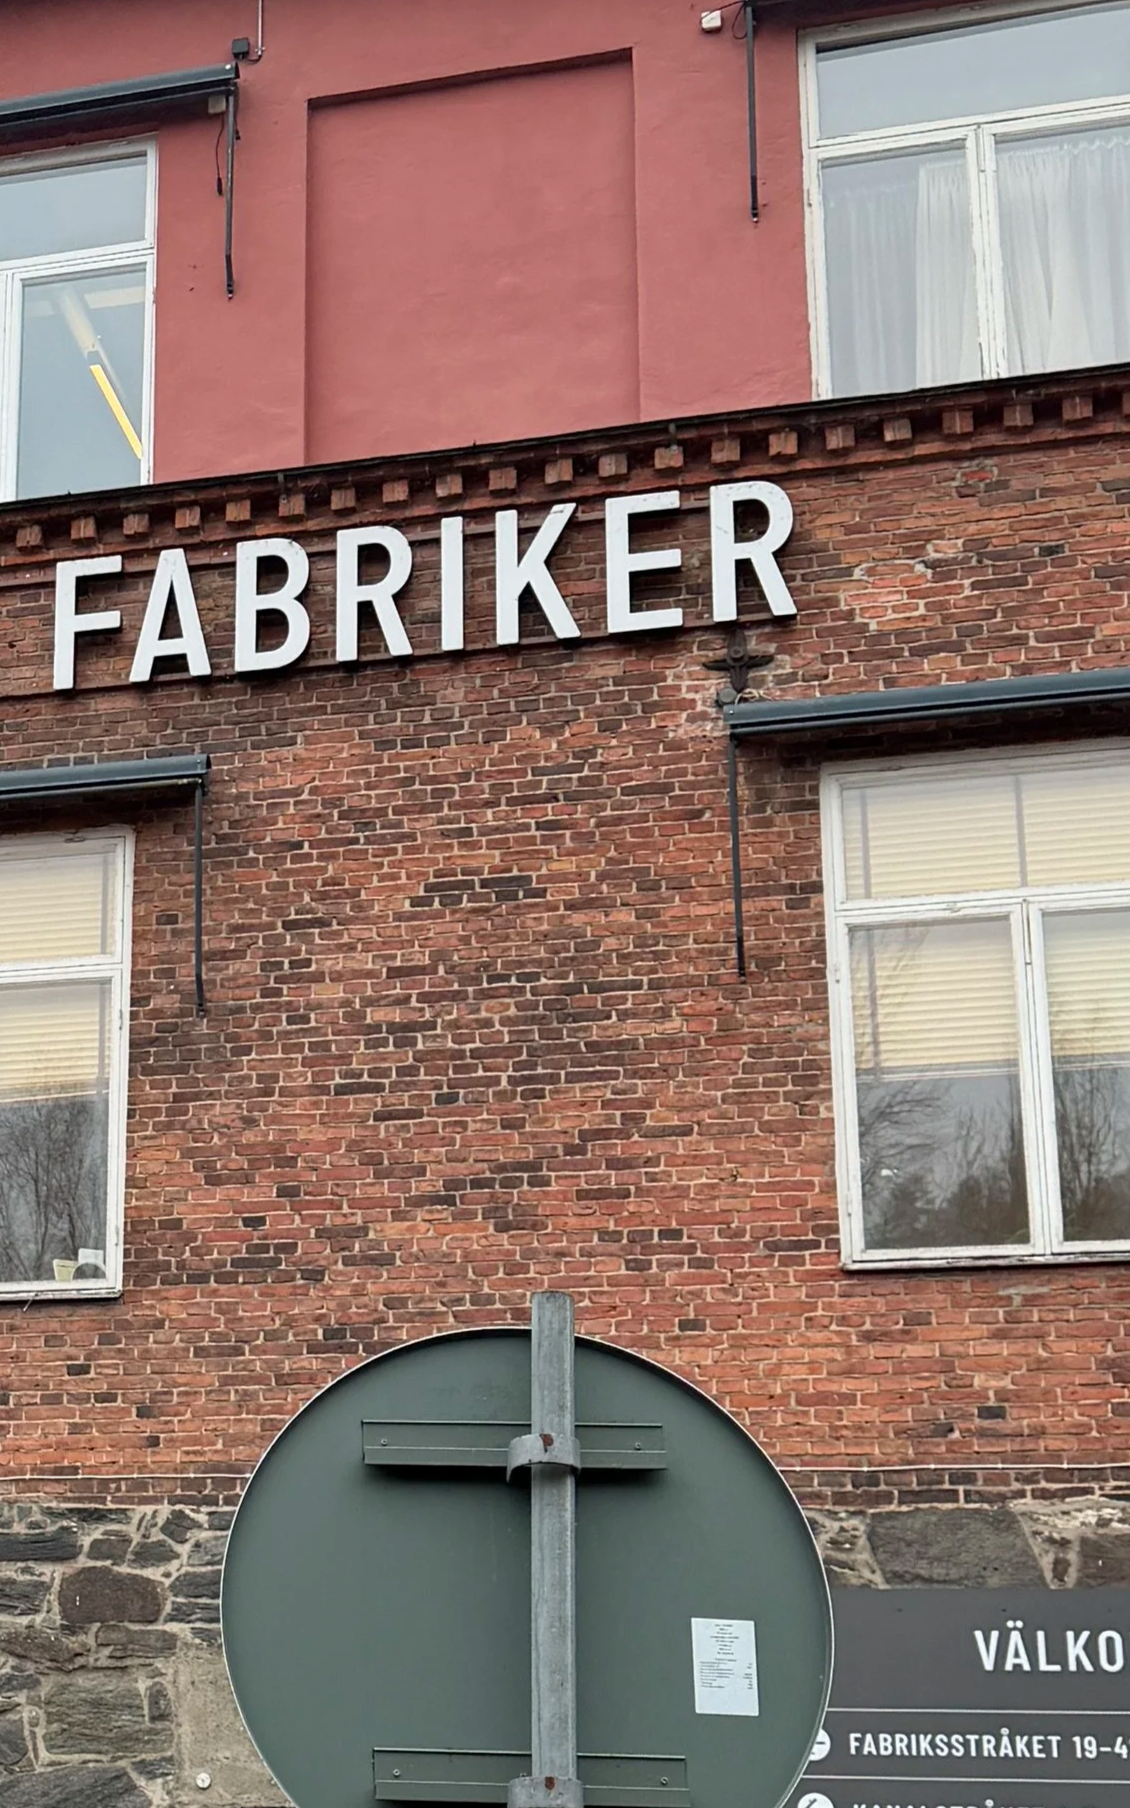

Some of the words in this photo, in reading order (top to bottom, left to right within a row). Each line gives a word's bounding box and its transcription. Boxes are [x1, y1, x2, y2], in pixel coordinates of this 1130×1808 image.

[53, 480, 797, 691] FABRIKER
[849, 1727, 1061, 1759] FABRIKSSTRÅKET
[1072, 1735, 1130, 1759] 19-4
